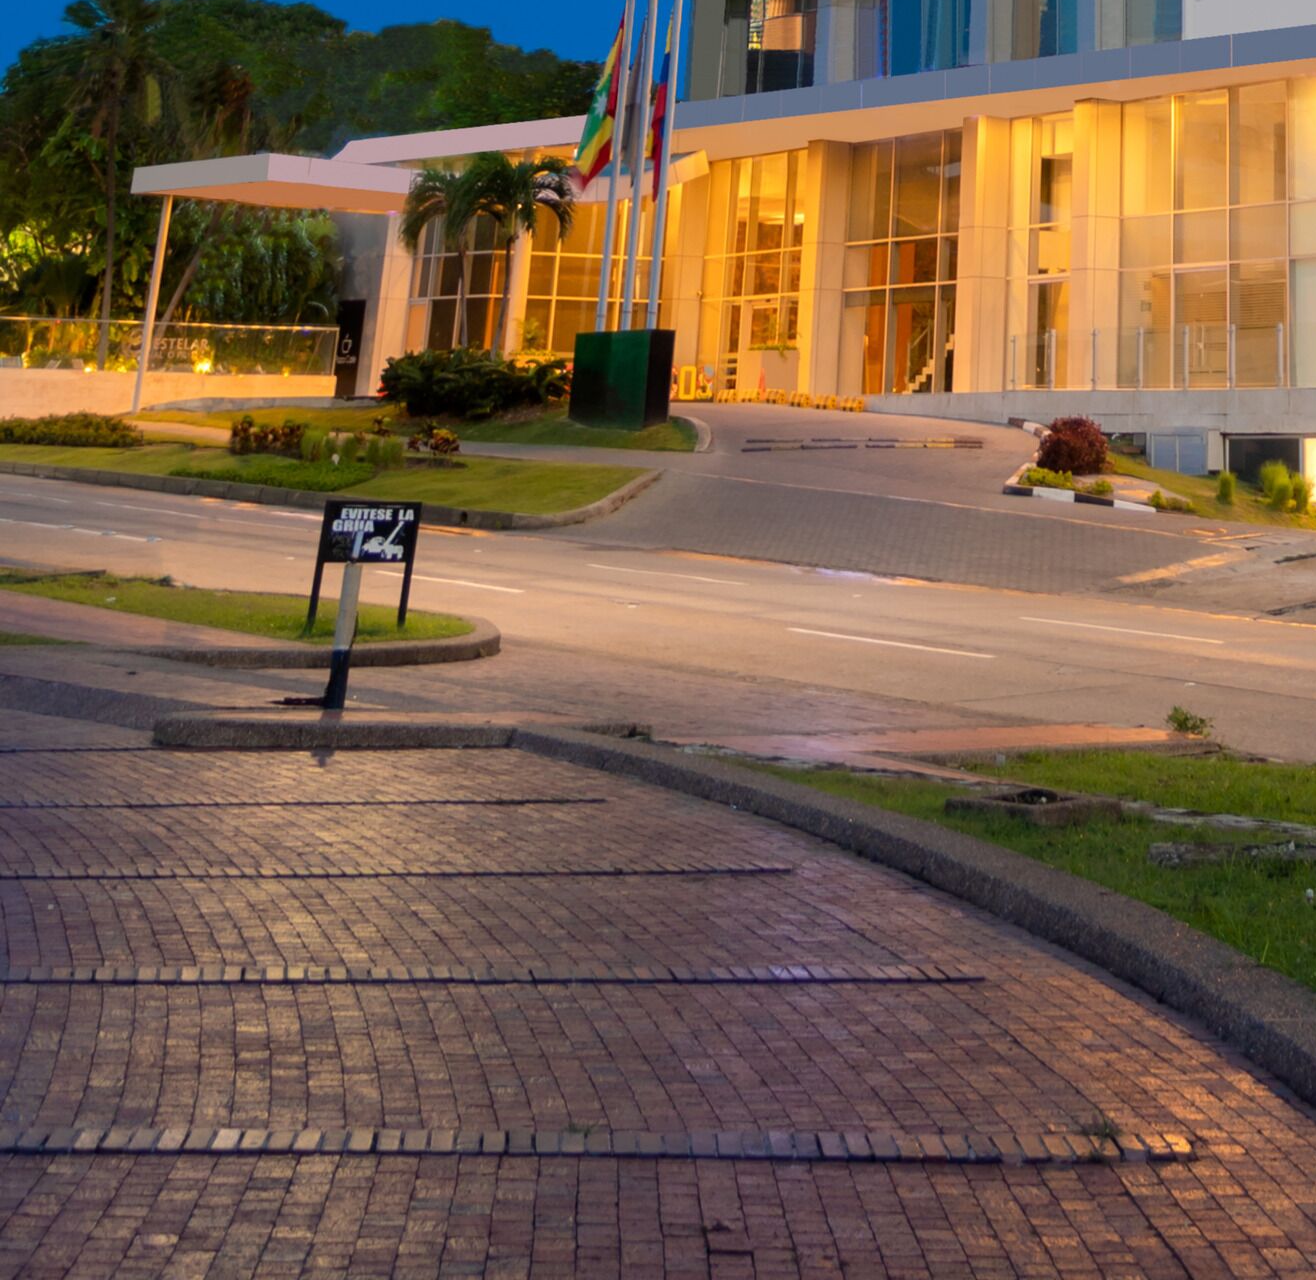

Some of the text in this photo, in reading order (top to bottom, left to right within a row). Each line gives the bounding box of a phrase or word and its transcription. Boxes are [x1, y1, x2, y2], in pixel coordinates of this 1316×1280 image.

[153, 337, 209, 350] ESTELAR
[341, 507, 414, 520] EVITESE LA
[332, 519, 374, 532] GRUA
